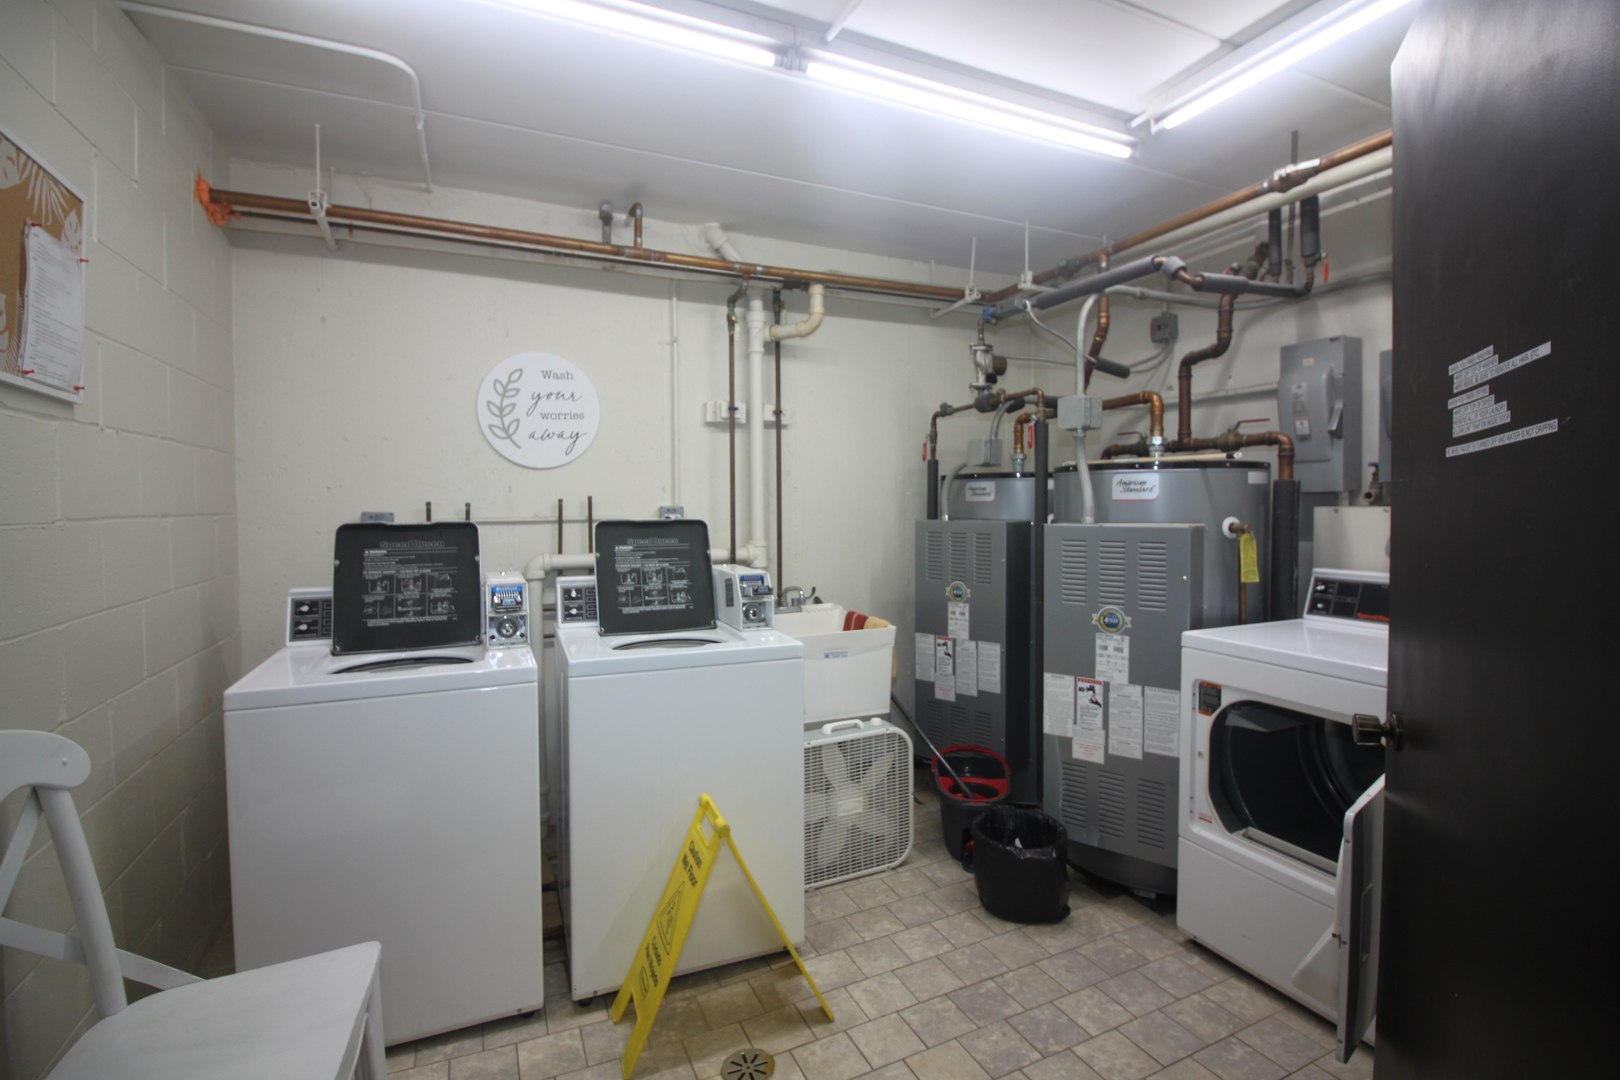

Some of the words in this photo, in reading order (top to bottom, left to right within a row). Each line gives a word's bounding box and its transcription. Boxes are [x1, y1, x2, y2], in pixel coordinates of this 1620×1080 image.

[1495, 360, 1510, 375] REMOVE
[1519, 352, 1529, 365] HAIR
[1530, 348, 1540, 360] ETC
[541, 370, 574, 380] Wash
[526, 391, 583, 417] your
[540, 412, 585, 420] worries
[528, 428, 588, 456] away
[1506, 430, 1520, 442] WATER
[1520, 429, 1526, 438] IS
[1526, 426, 1534, 437] NOT
[1535, 420, 1556, 435] DRIPPING
[1116, 478, 1147, 487] American
[689, 840, 702, 869] Caution
[686, 864, 698, 888] Floor
